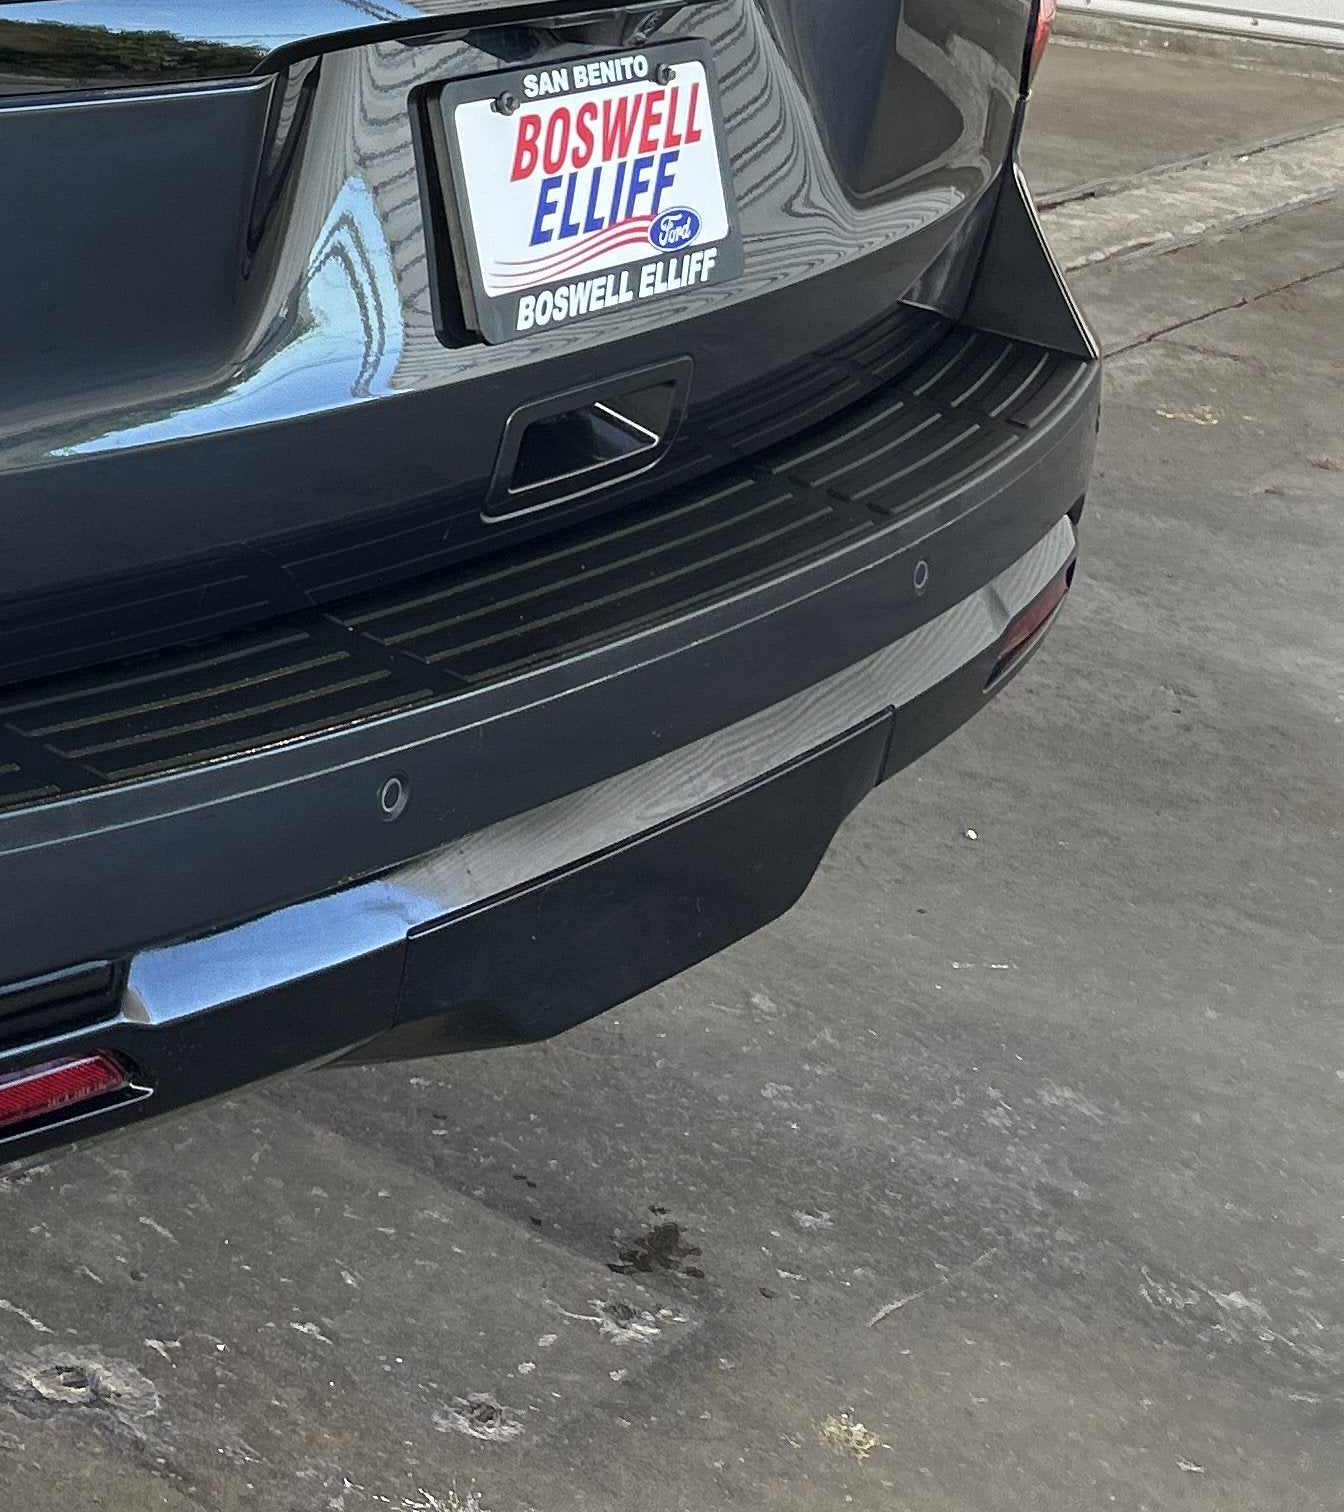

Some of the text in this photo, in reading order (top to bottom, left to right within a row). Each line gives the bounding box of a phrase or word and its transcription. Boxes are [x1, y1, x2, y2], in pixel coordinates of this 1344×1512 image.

[523, 55, 649, 98] SAN BENITO
[510, 82, 703, 183] BOSWELL
[529, 150, 680, 247] ELLIFF
[657, 212, 693, 246] Ford
[516, 248, 718, 331] BOSWELL ELLIFF
